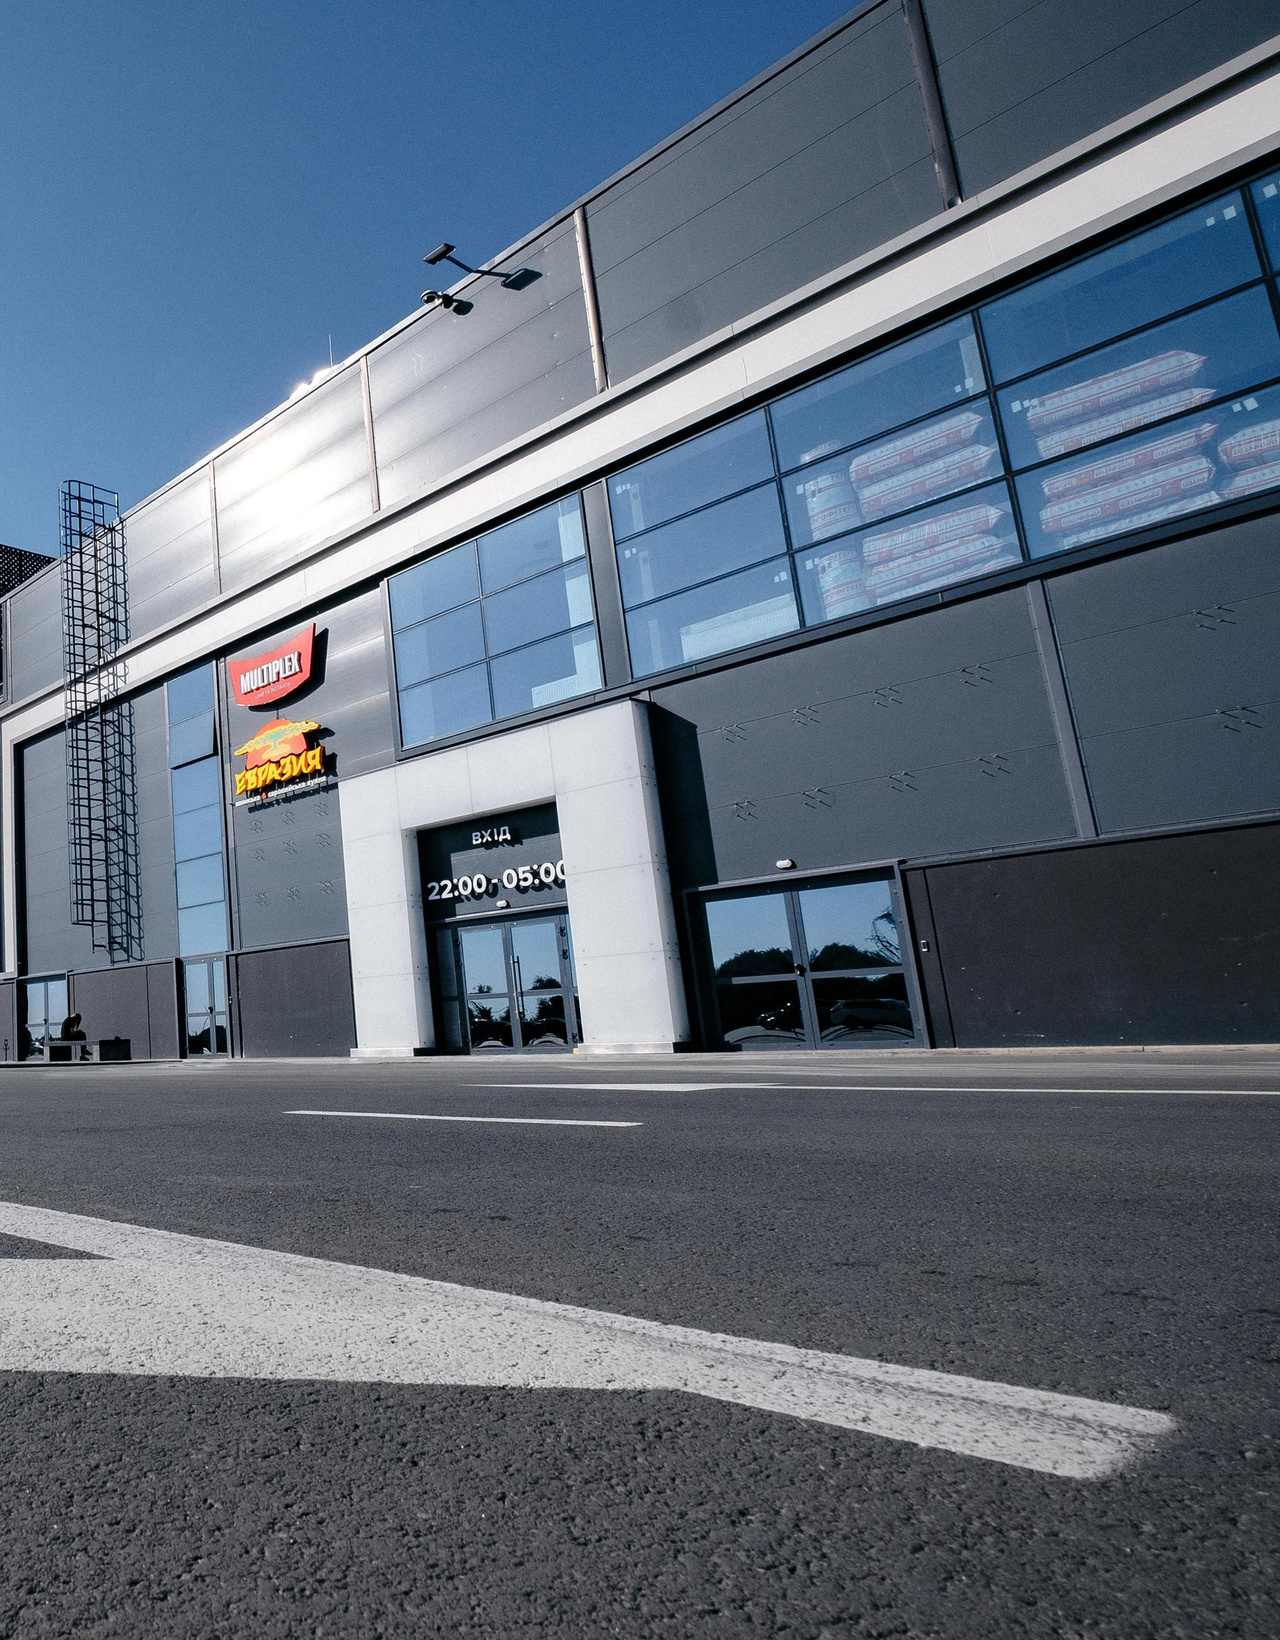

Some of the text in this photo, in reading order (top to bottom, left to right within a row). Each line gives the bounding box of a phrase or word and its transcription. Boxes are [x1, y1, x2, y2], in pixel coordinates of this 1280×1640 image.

[240, 651, 302, 694] MULTIPLEX
[234, 746, 324, 795] ЕВРАЗИЯ
[472, 826, 511, 845] ВХІД
[427, 873, 487, 900] 22:00
